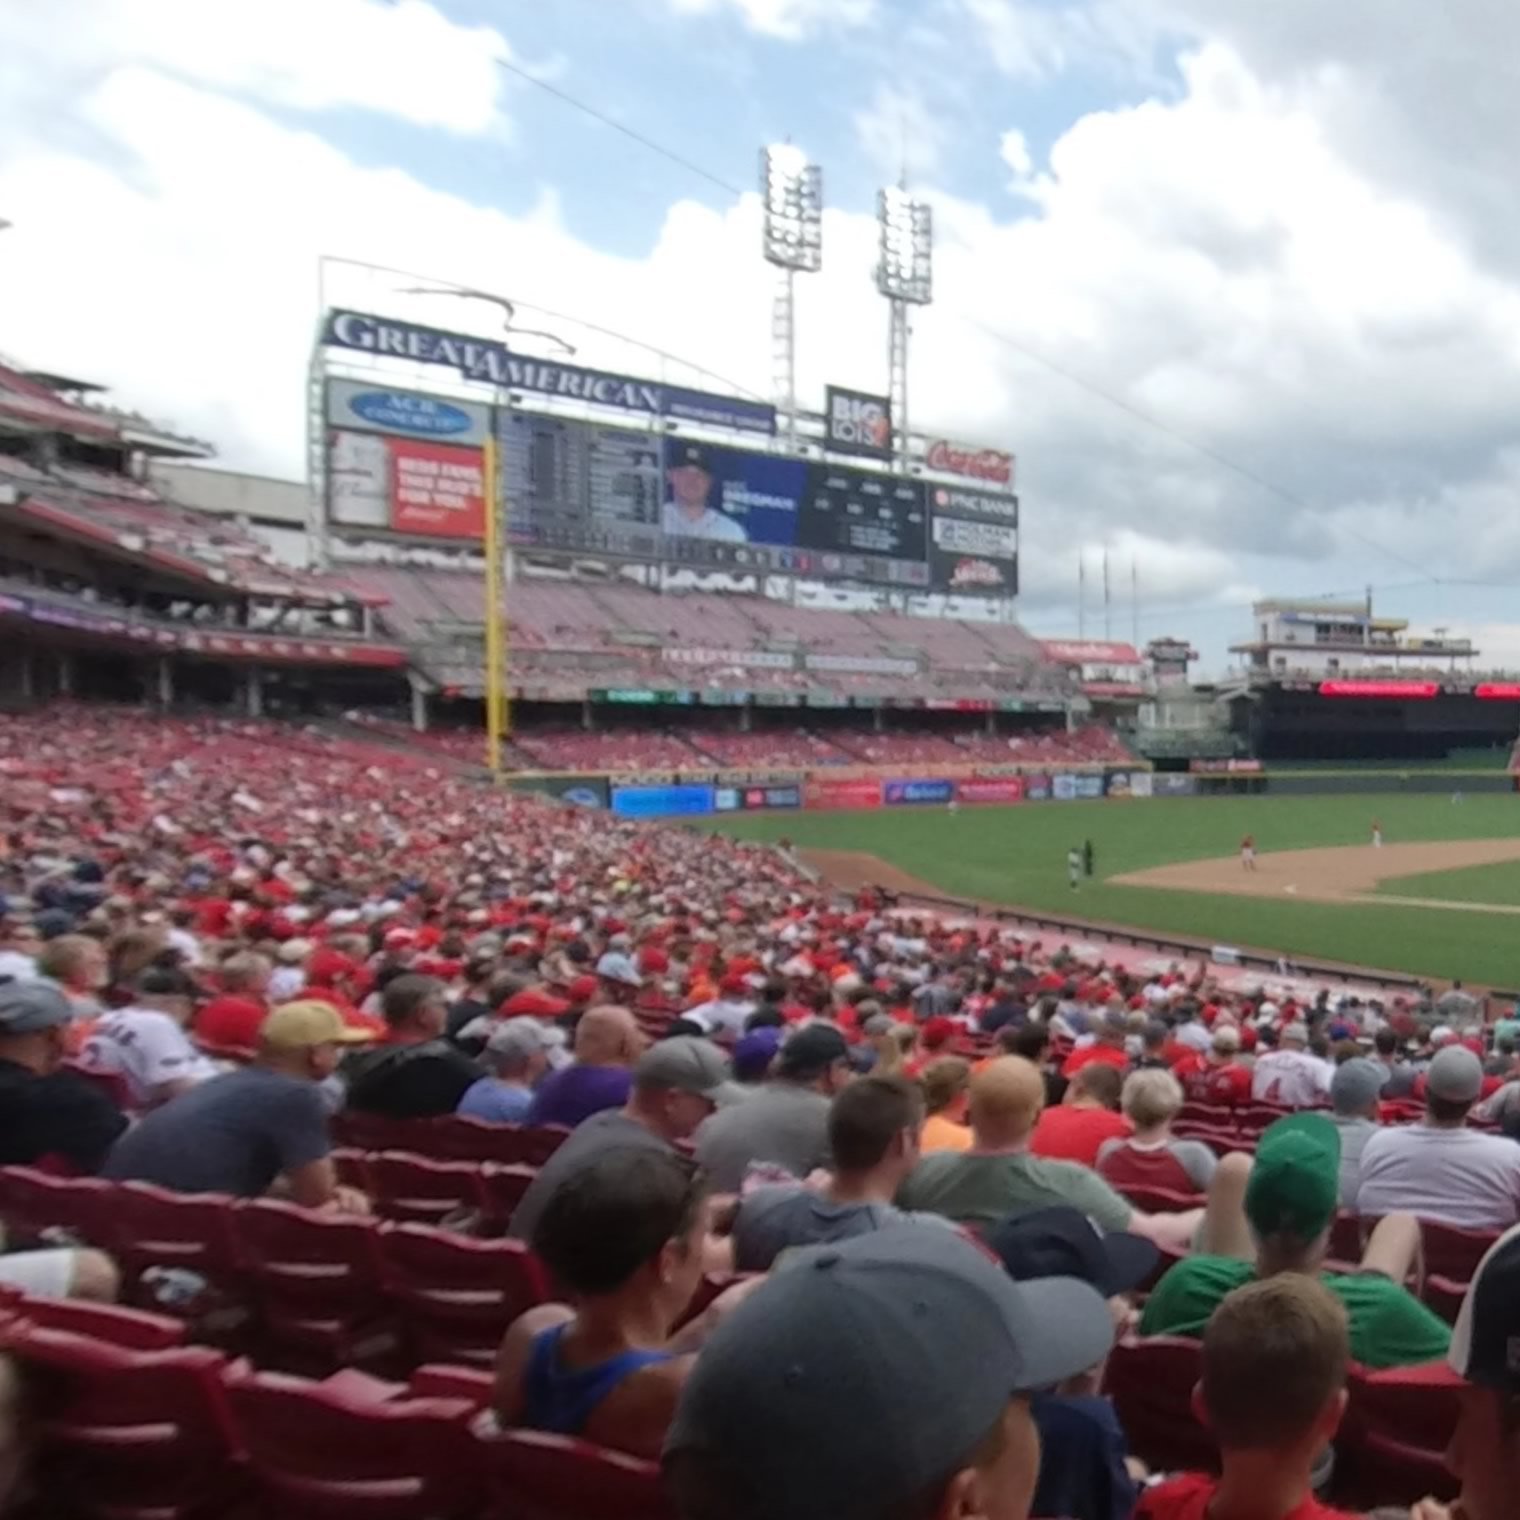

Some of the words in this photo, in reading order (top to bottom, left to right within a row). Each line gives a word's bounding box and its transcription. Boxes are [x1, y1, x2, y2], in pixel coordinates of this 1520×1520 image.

[470, 353, 662, 411] AMERICAN
[832, 397, 882, 425] BIG
[832, 420, 876, 446] LOTS
[927, 439, 1010, 483] Coca-Cola
[950, 493, 979, 511] PNC
[980, 498, 1015, 517] BANK
